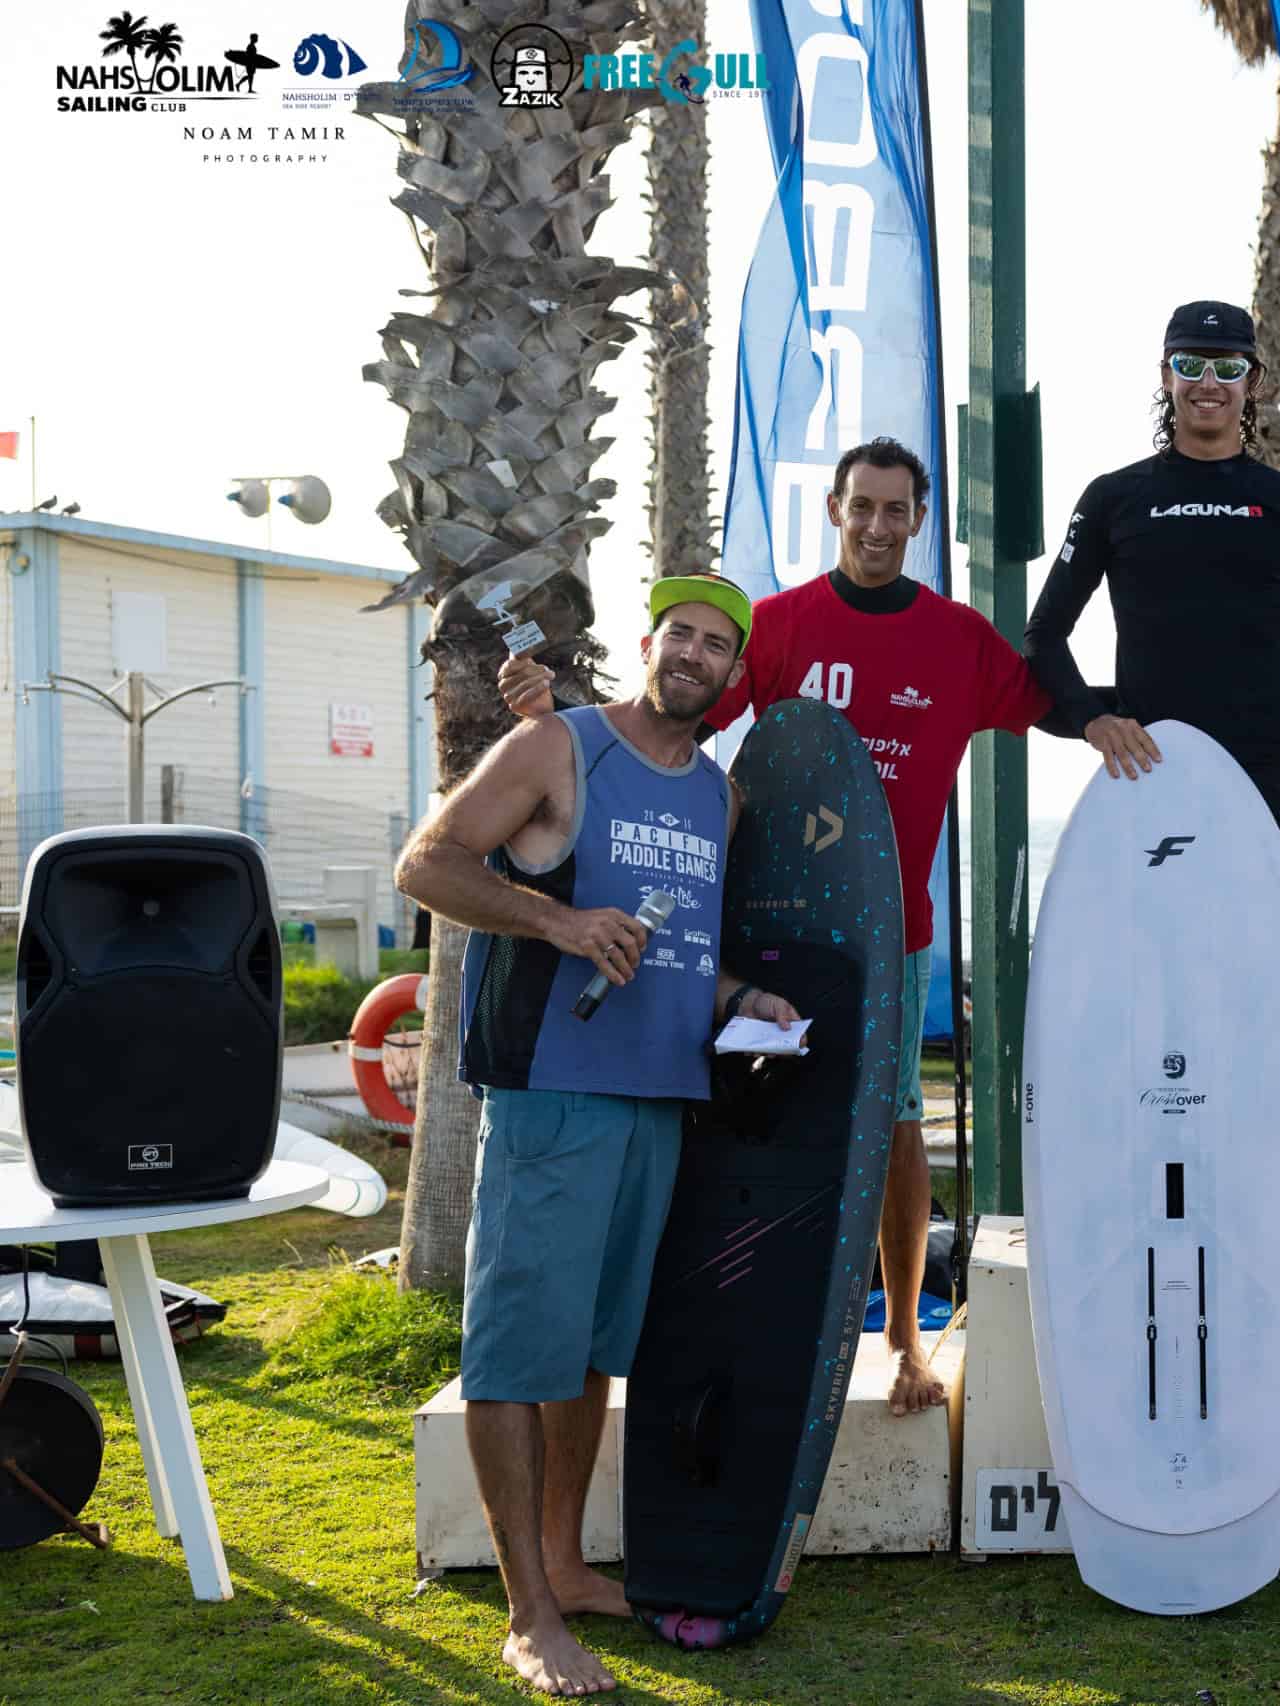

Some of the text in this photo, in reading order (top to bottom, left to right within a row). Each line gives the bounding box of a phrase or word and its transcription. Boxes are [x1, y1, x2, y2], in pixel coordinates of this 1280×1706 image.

[798, 661, 853, 709] 40
[611, 819, 717, 861] PACIFIC
[610, 841, 672, 872] PADDLE
[675, 852, 717, 883] GAMES
